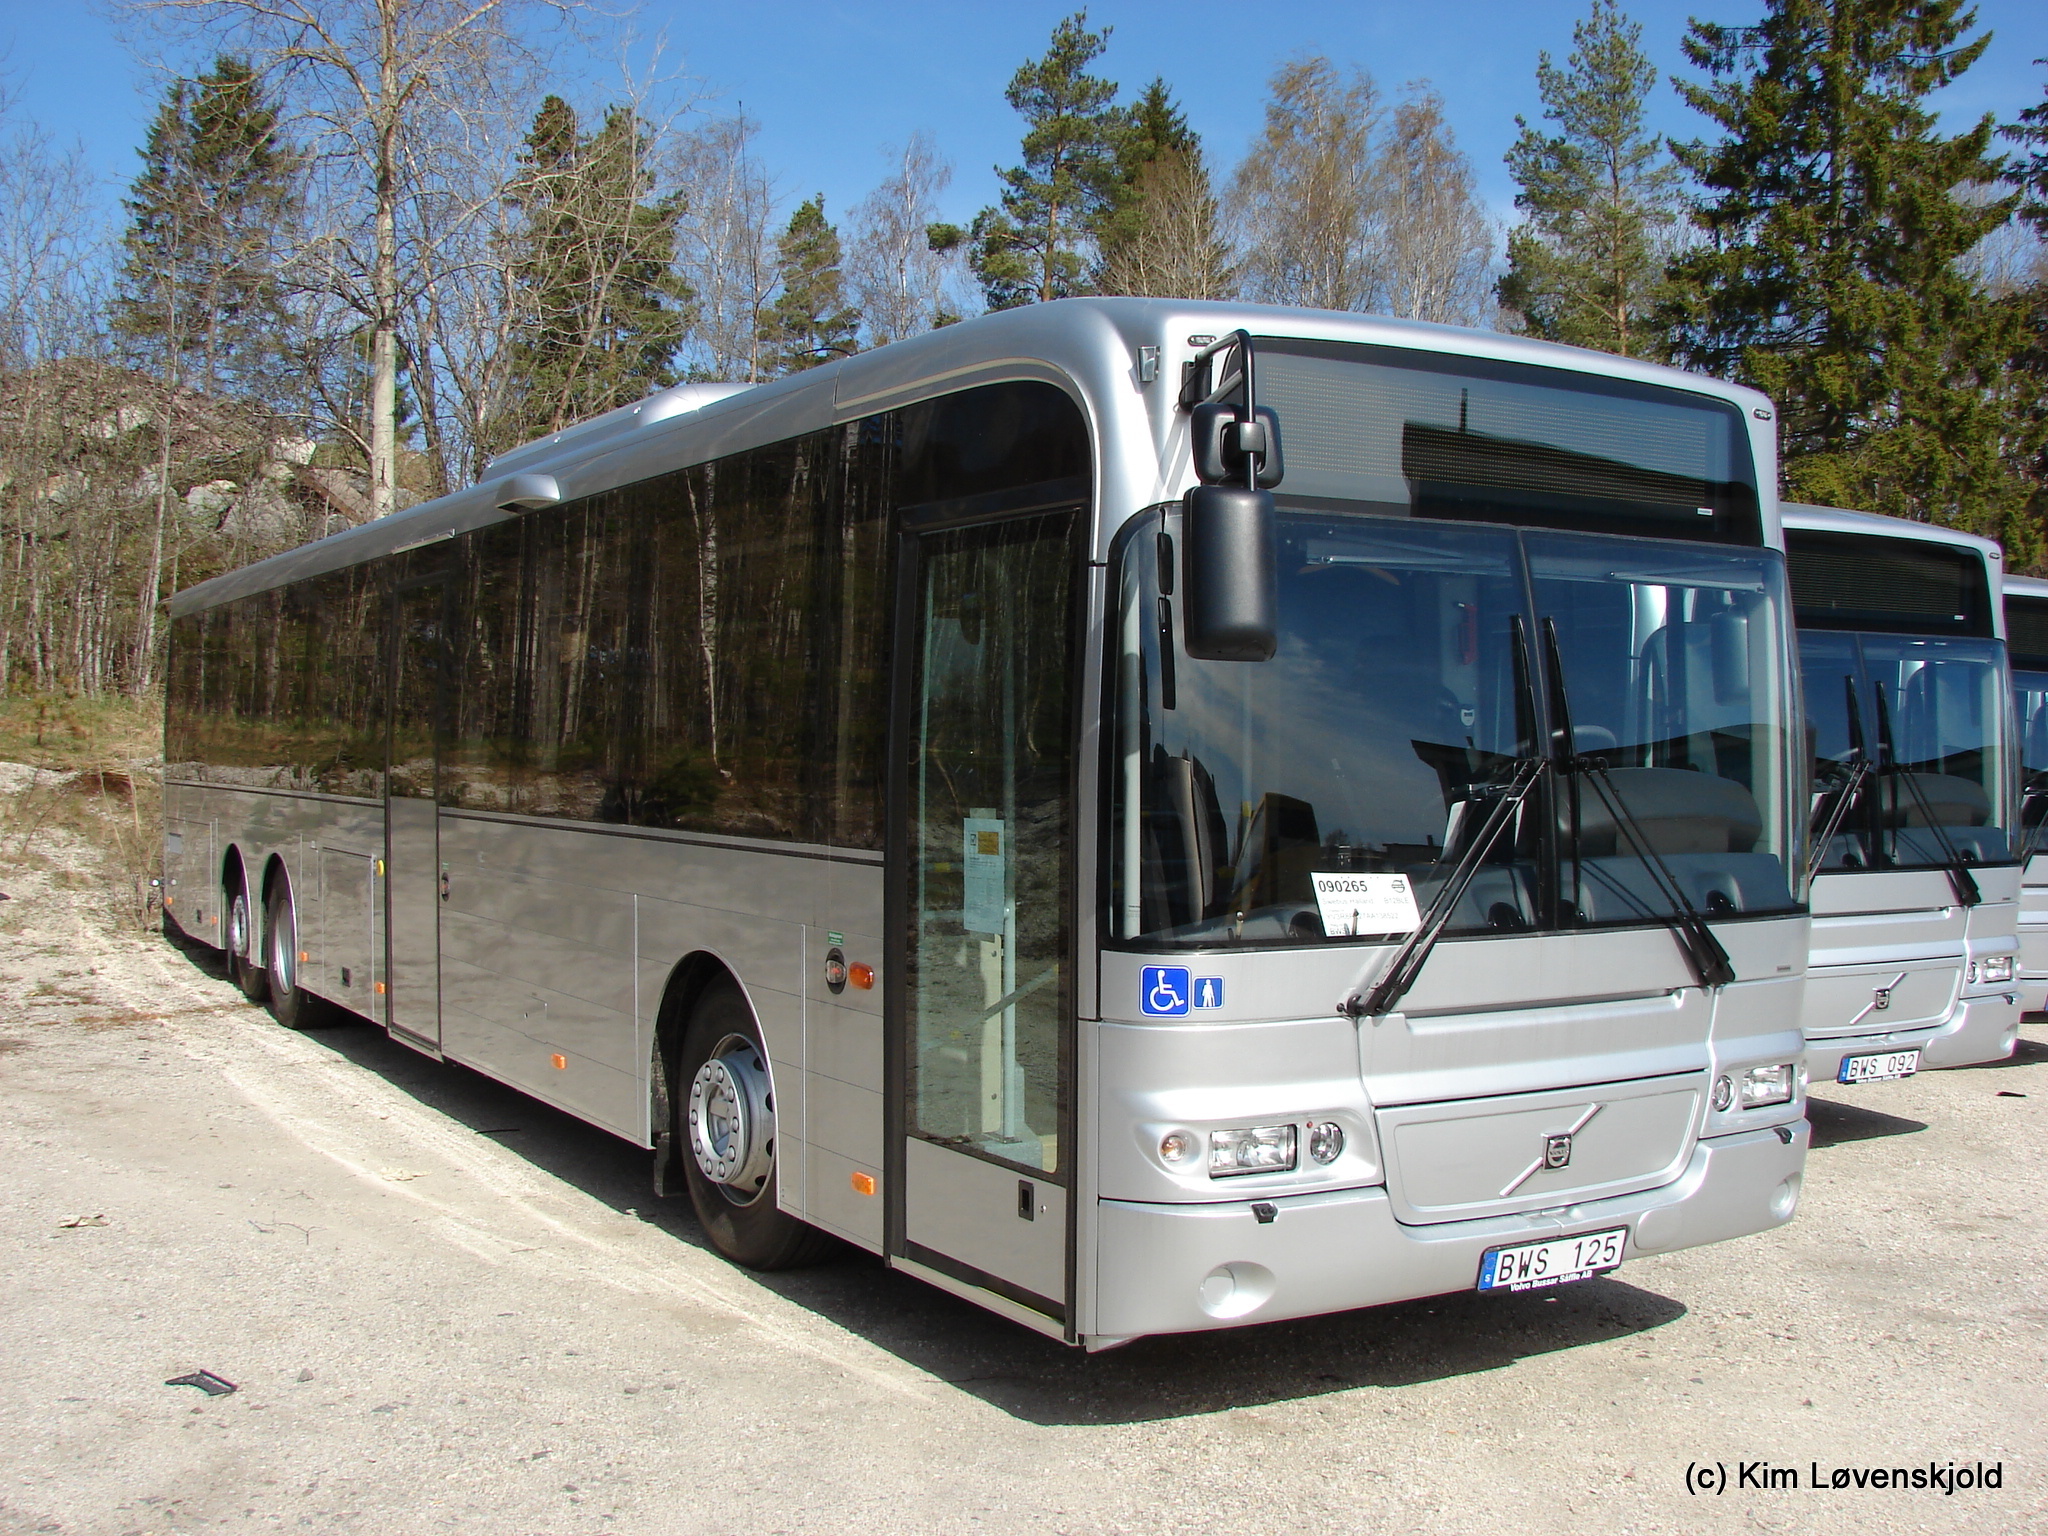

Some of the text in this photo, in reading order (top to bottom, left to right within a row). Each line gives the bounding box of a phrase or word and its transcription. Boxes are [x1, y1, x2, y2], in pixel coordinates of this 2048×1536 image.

[1318, 880, 1368, 892] 090265
[1849, 1054, 1915, 1077] BWS 092
[1498, 1235, 1618, 1282] BWS 125
[1511, 1282, 1530, 1292] Volvo
[1532, 1277, 1558, 1288] Bussar
[1581, 1270, 1593, 1279] AB
